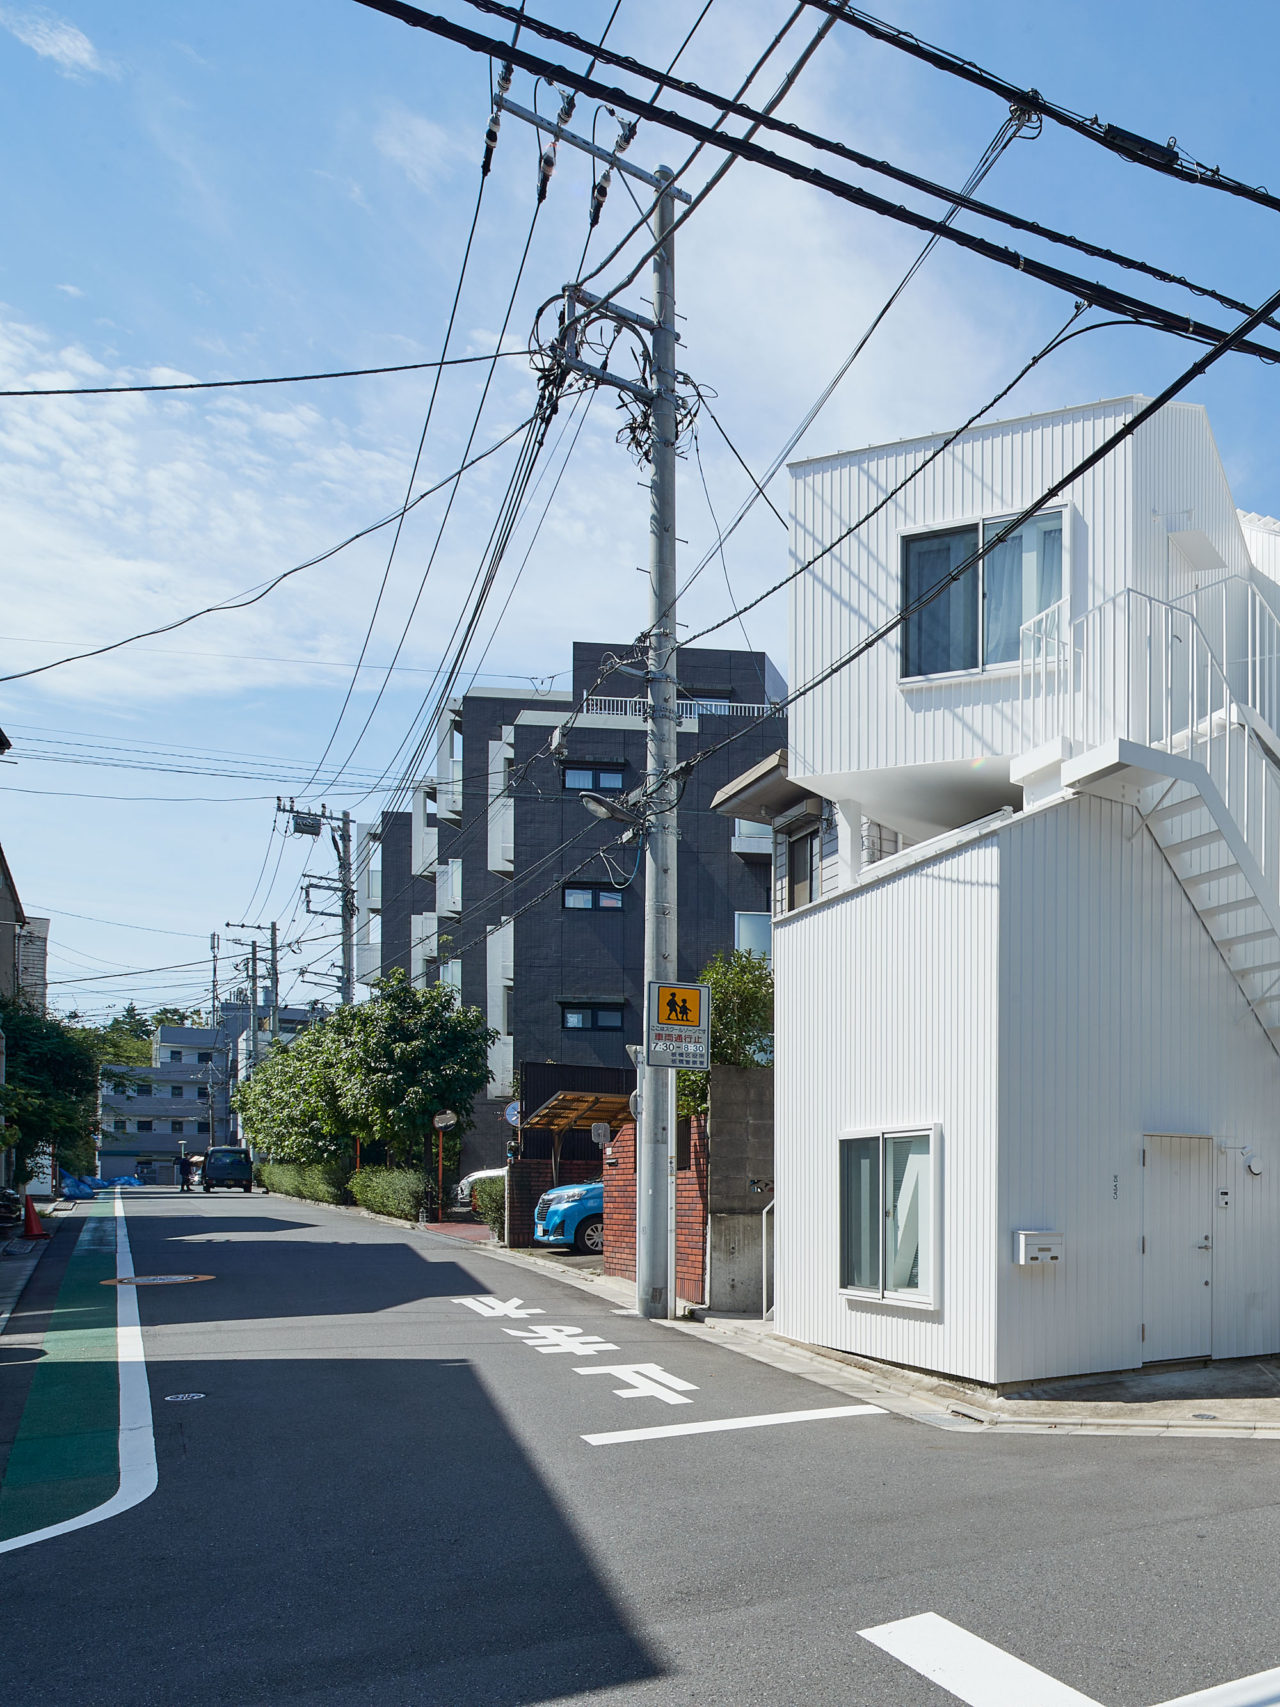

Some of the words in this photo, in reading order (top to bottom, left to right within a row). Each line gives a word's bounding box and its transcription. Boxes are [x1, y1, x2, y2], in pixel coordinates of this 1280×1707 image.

[651, 1025, 706, 1034] ここはスクールゾーンです
[655, 1033, 702, 1043] 車両通行止
[653, 1043, 675, 1051] 7:30
[683, 1044, 704, 1052] 8:30
[450, 1297, 701, 1405] 止まれ
